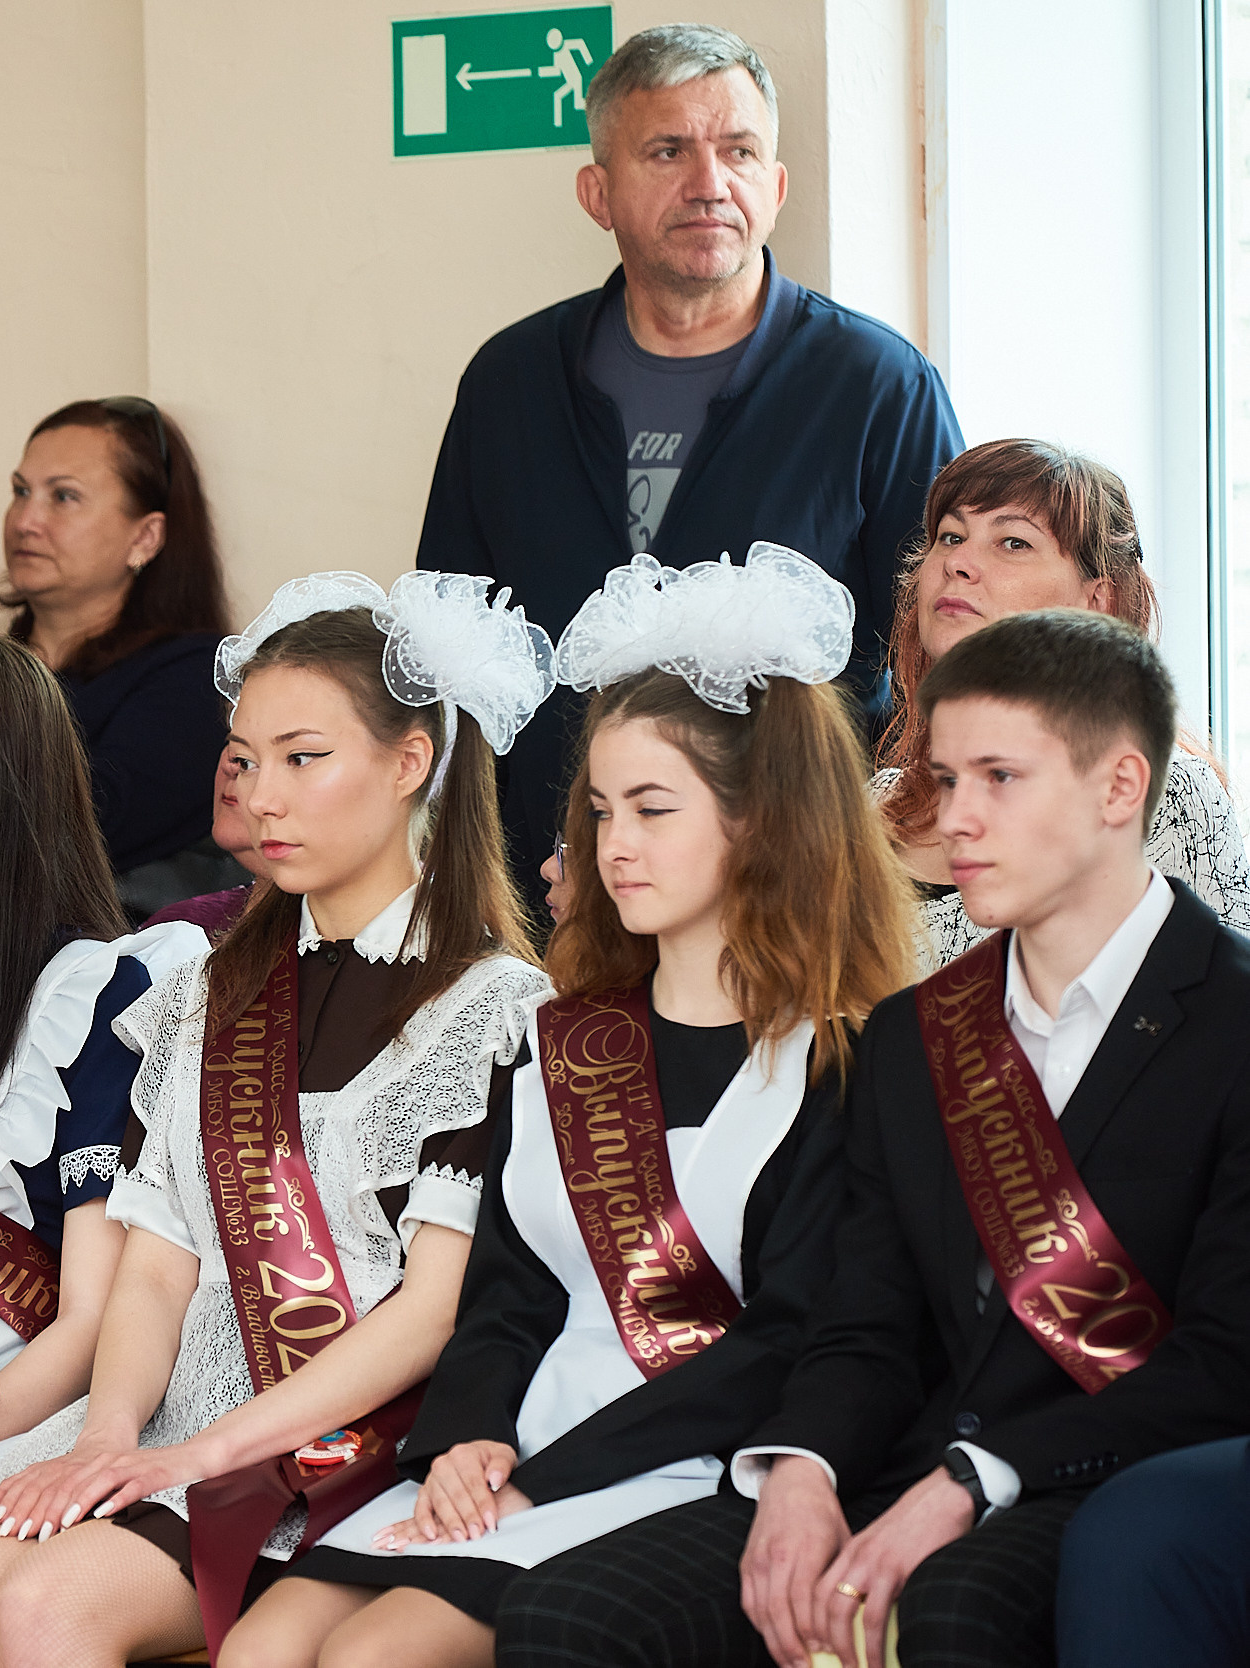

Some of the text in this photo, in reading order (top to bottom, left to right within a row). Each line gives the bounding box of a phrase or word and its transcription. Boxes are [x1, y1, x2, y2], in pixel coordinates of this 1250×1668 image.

[627, 431, 683, 461] FOR
[206, 1076, 229, 1143] МБОУ
[239, 1282, 276, 1391] Владивост
[562, 1007, 714, 1355] Выпускник
[932, 938, 1069, 1264] Выпускник
